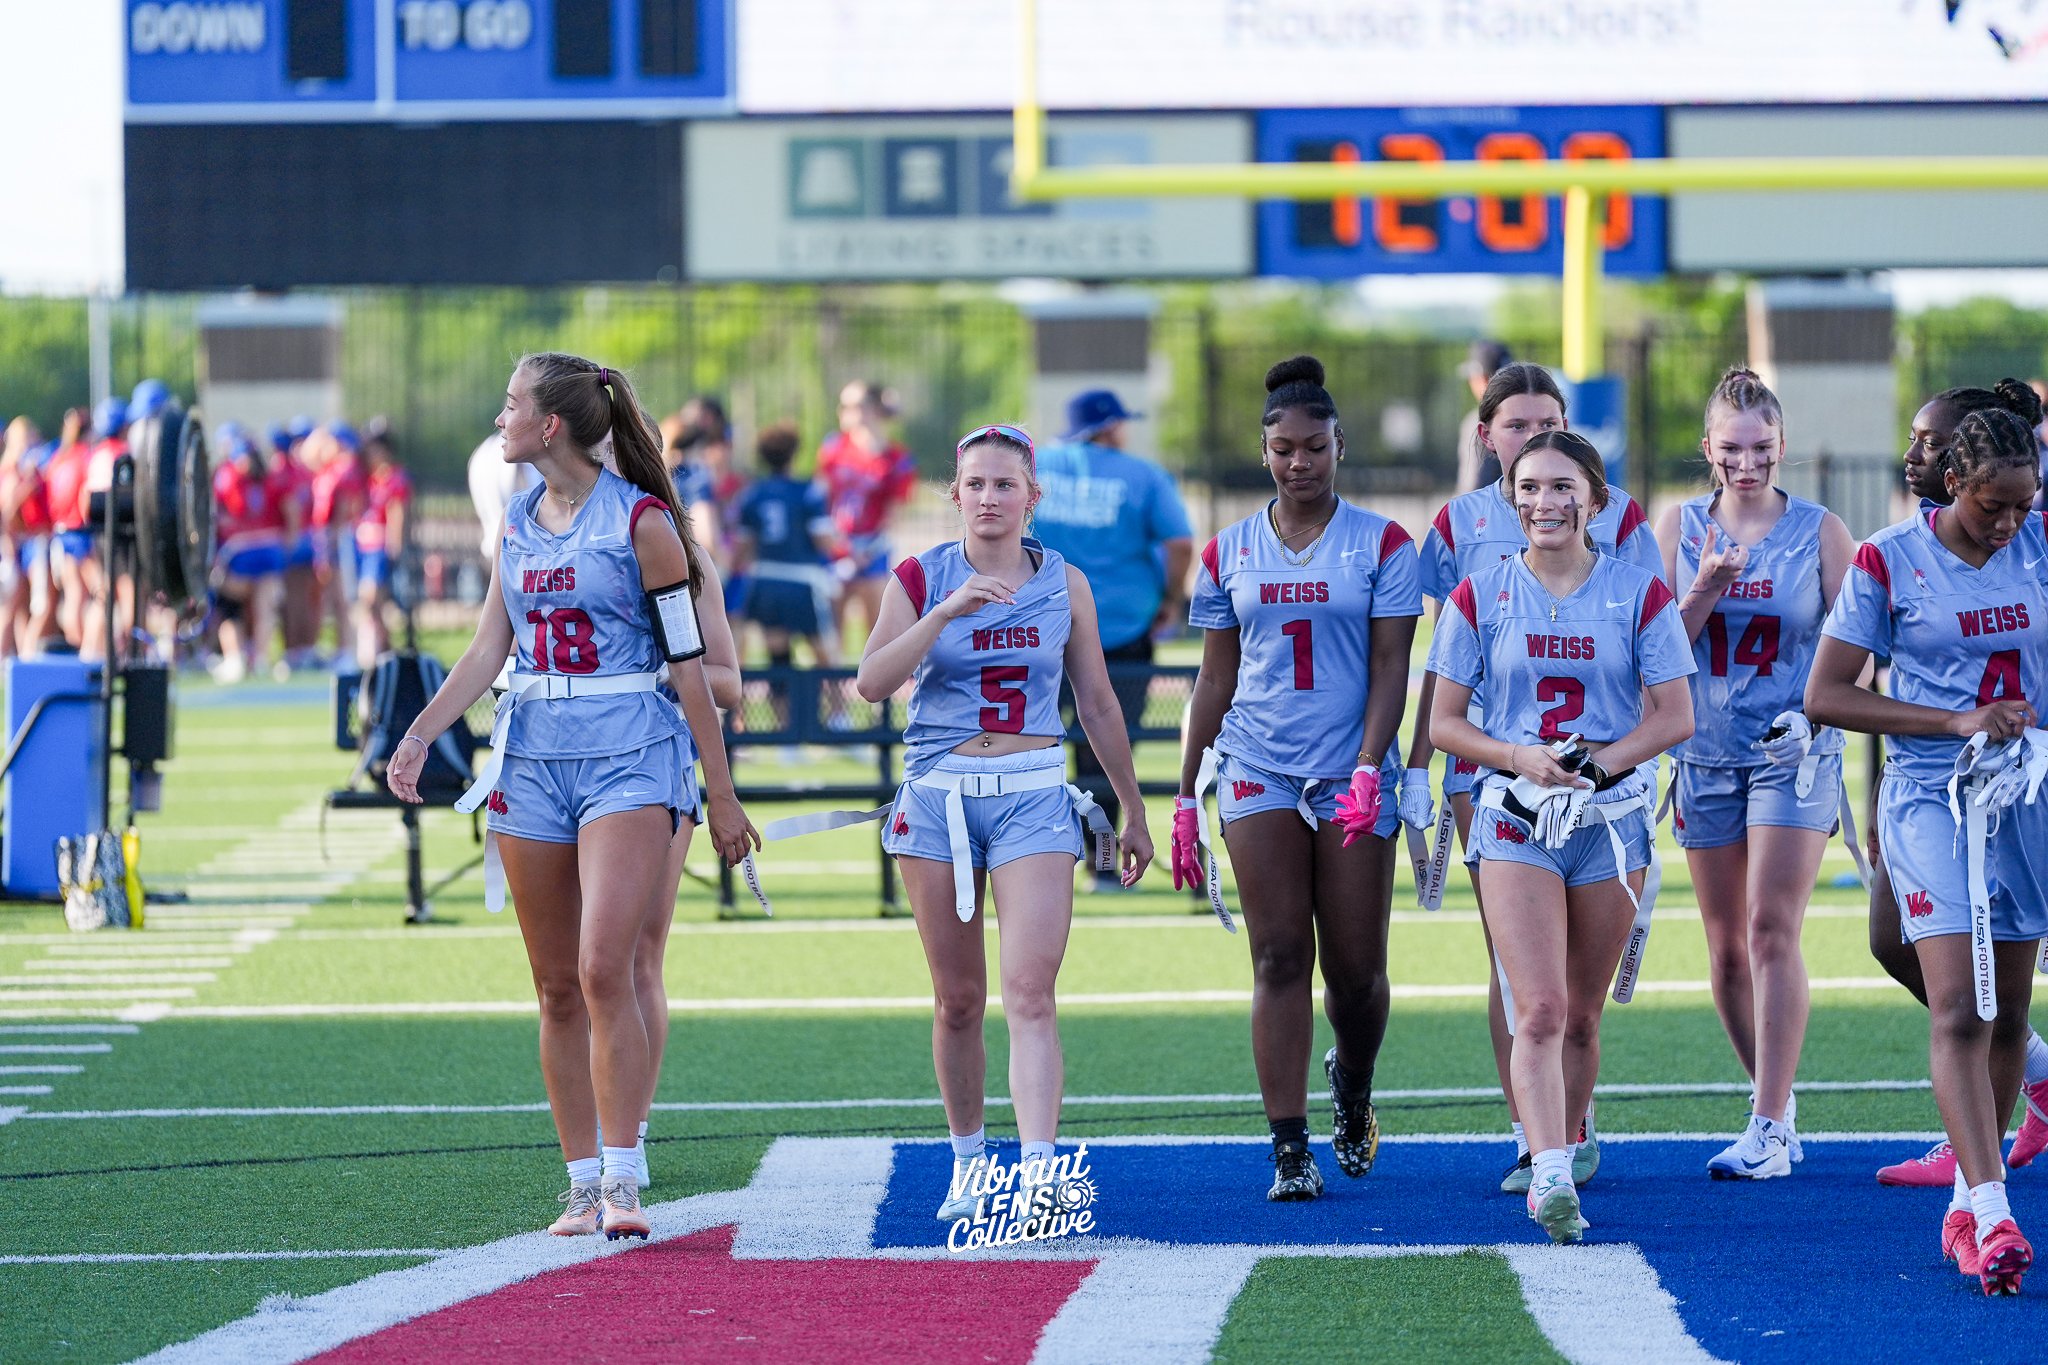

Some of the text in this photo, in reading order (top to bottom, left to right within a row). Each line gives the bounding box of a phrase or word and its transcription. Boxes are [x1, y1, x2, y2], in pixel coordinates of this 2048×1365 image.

[131, 2, 266, 52] DOWN
[400, 1, 532, 50] TO GO
[522, 567, 576, 594] WEISS
[1260, 582, 1330, 604] WEISS
[526, 608, 600, 674] 18
[972, 627, 1040, 651] WEISS
[1525, 634, 1596, 661] WEISS
[1706, 611, 1781, 677] 14
[1956, 602, 2031, 638] WEISS
[1281, 619, 1315, 691] 1
[1976, 649, 2027, 709] 4
[979, 665, 1030, 735] 5
[1536, 676, 1586, 740] 2
[1429, 820, 1451, 902] USA FOOTBALL
[1618, 935, 1642, 996] USA FOOTBALL
[1976, 916, 1991, 1010] USA FOOTBALL
